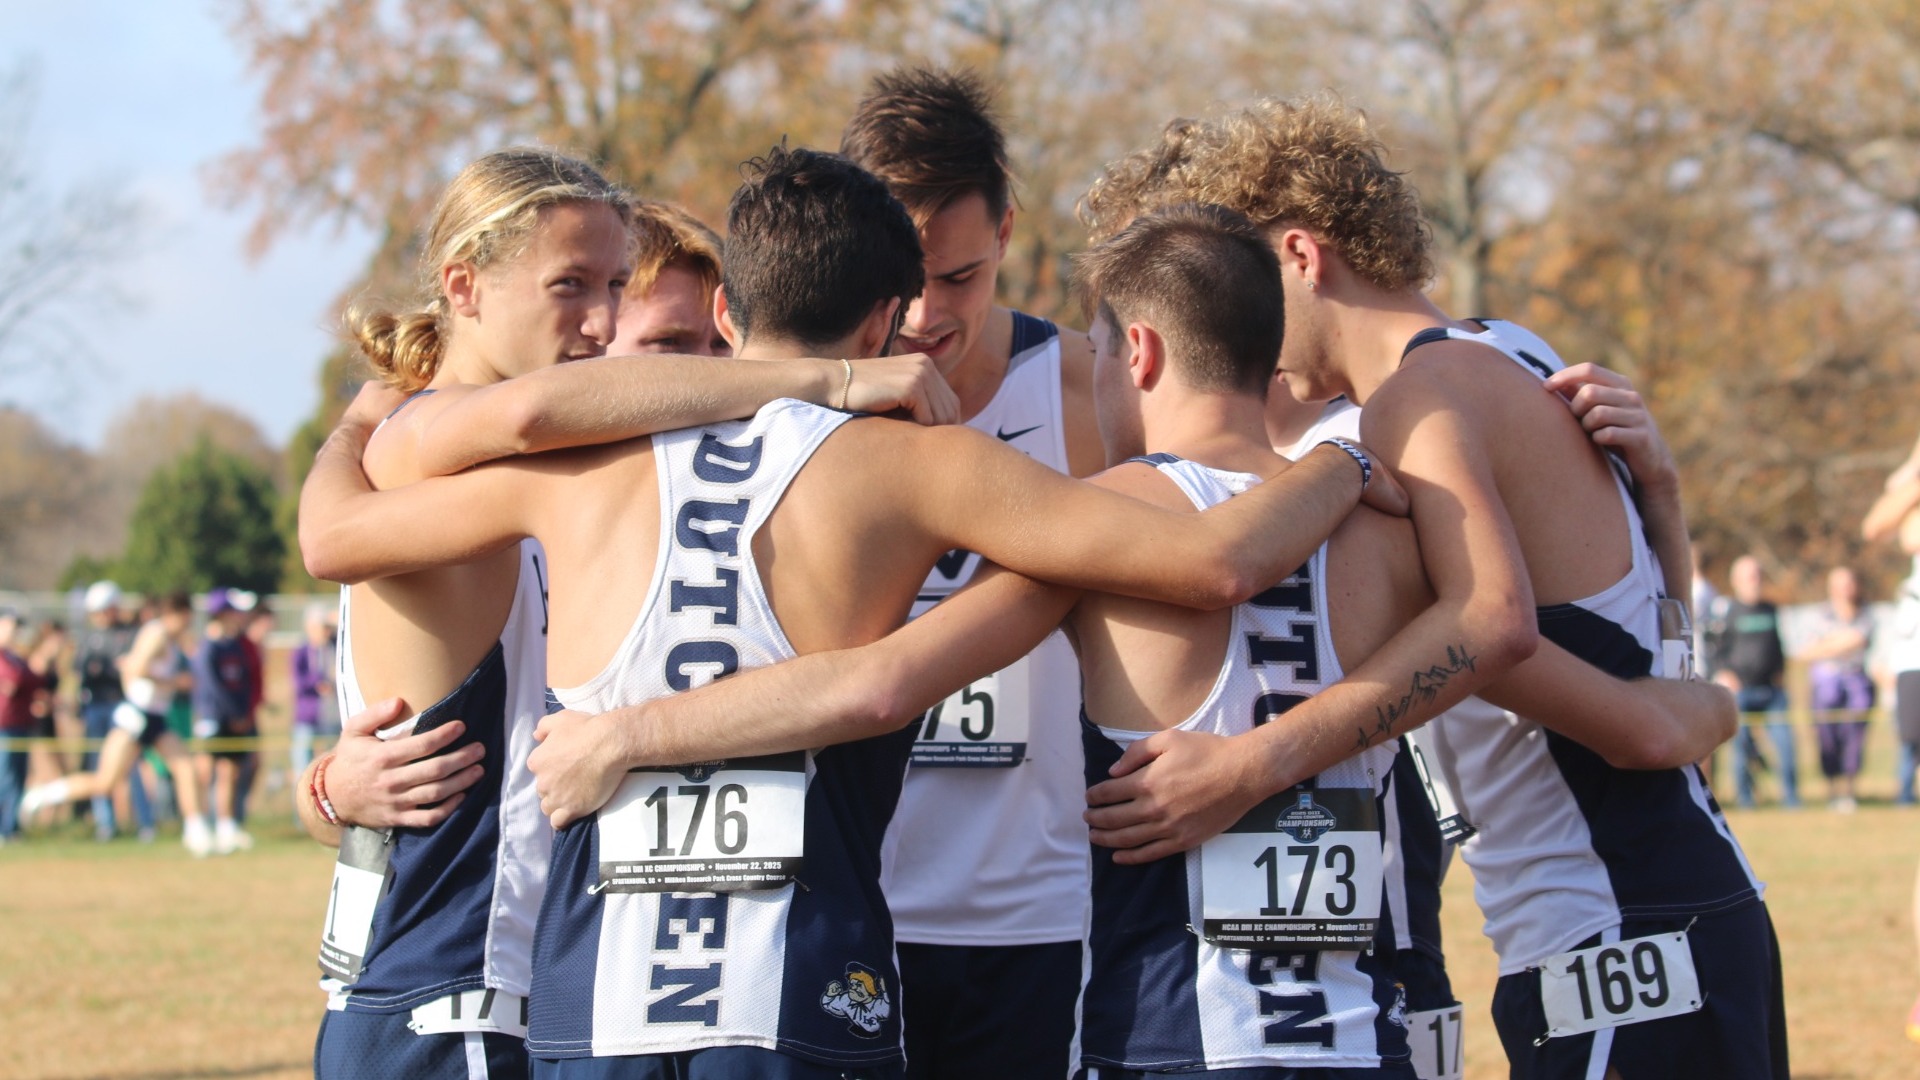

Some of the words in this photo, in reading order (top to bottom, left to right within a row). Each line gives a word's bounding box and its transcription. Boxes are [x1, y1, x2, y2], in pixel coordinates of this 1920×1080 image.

[646, 430, 765, 1028] DUTCEN
[644, 783, 749, 857] 176
[1277, 819, 1335, 827] CHAMPIONSHIPS
[615, 865, 632, 874] NCAA
[644, 864, 654, 873] XC
[654, 863, 706, 873] CHAMPIONSHIPS
[714, 862, 749, 871] November
[749, 861, 762, 870] 22,
[763, 861, 782, 870] 2025
[686, 875, 712, 883] Research
[726, 874, 742, 882] Cross
[765, 873, 786, 881] Course
[1253, 844, 1357, 917] 173
[1221, 923, 1240, 931] NCAA
[1253, 923, 1263, 931] XC
[1264, 923, 1317, 931] CHAMPIONSHIPS
[1326, 923, 1358, 931] November
[1216, 934, 1255, 942] SPARTANBURG,
[1565, 941, 1670, 1021] 169
